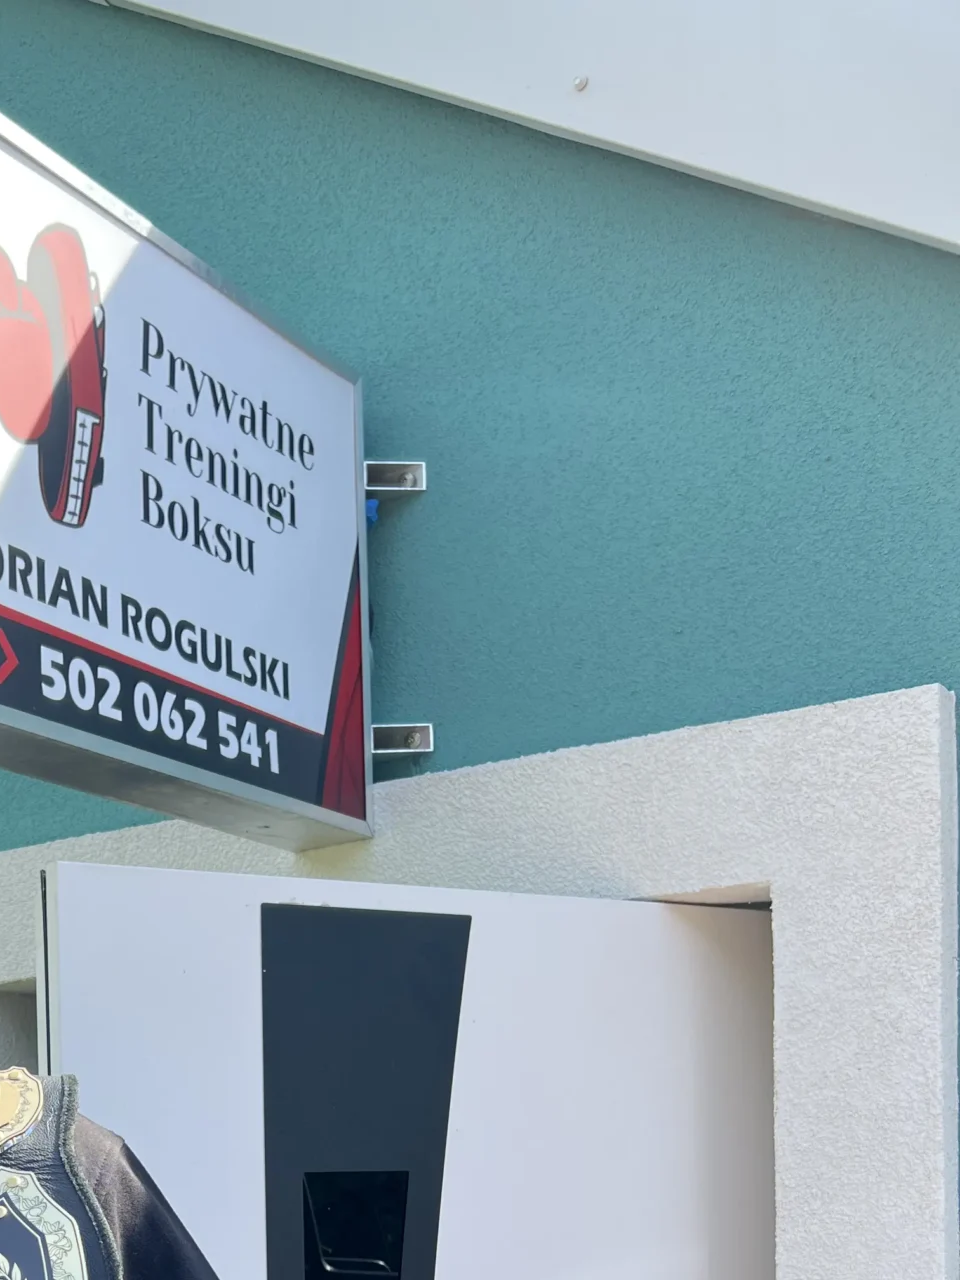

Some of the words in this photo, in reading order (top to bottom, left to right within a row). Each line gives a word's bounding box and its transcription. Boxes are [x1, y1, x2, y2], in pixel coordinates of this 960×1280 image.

[140, 317, 315, 471] Prywatne
[138, 393, 298, 534] Treningi
[140, 469, 256, 575] Boksu
[40, 644, 123, 722] 502
[134, 681, 207, 750] 062
[218, 709, 281, 774] 541
[121, 593, 290, 700] ROGULSKI
